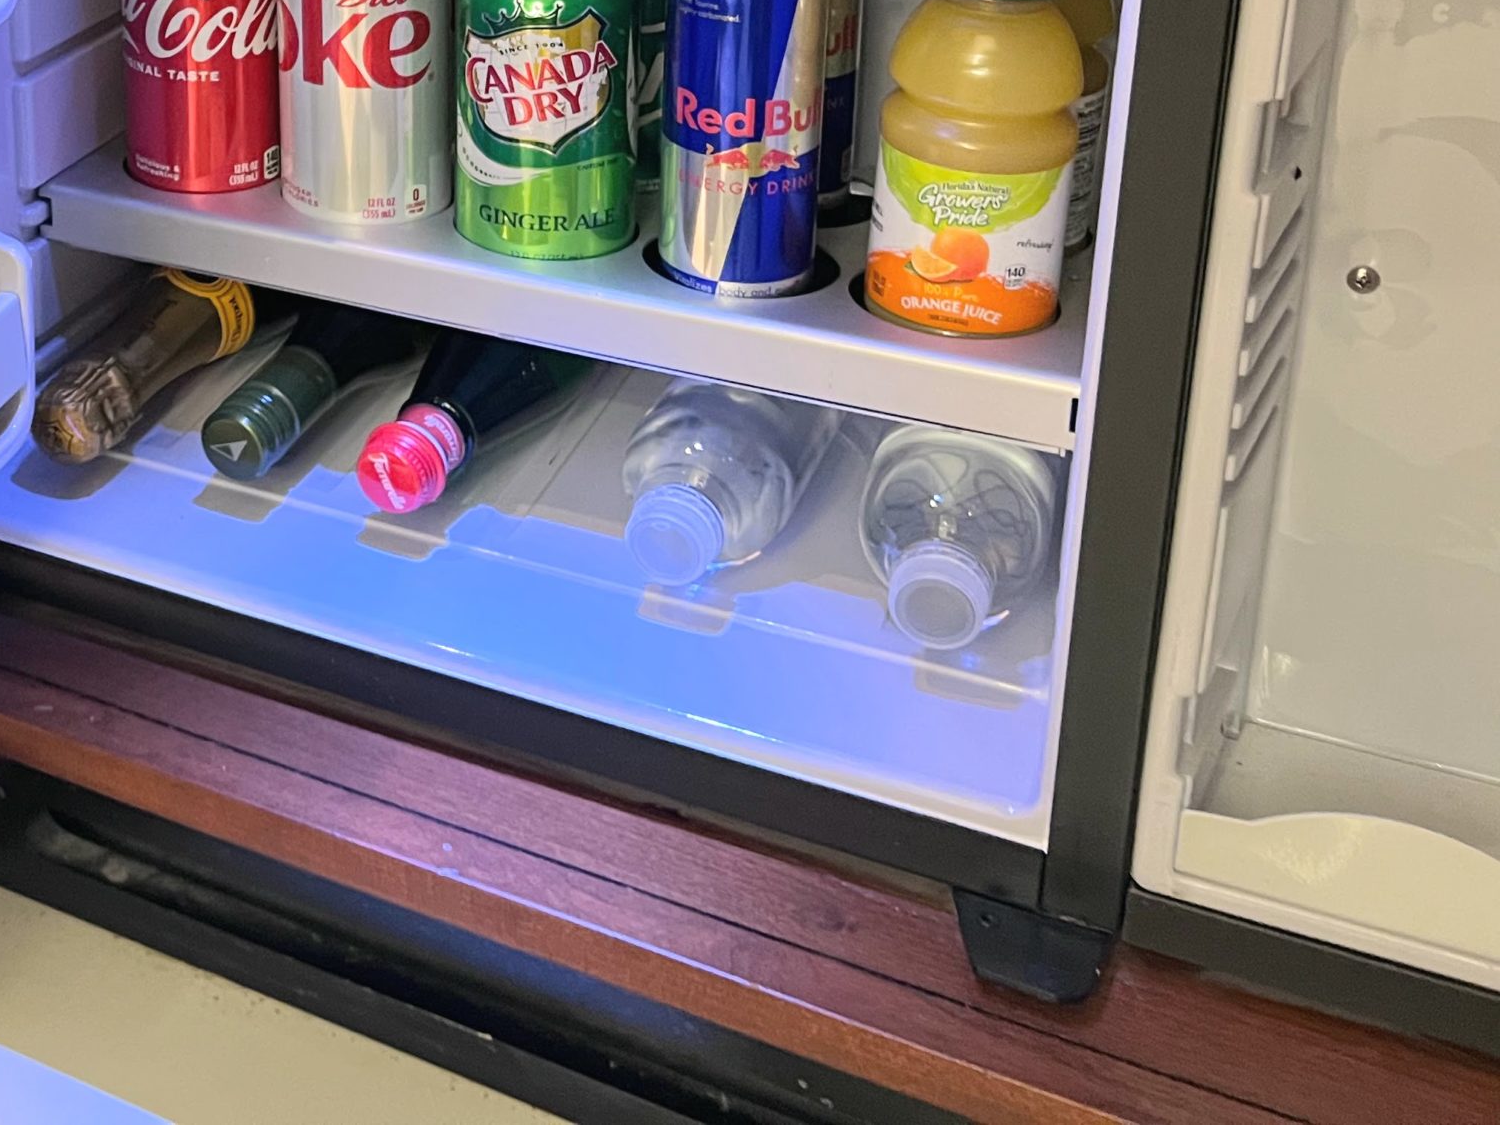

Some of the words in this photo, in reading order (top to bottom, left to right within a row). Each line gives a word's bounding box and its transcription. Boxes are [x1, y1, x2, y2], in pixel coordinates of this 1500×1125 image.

[499, 44, 529, 56] SINCE
[167, 69, 220, 82] TASTE
[466, 40, 618, 104] CANADA
[502, 81, 584, 127] DRY
[676, 86, 756, 138] Red
[412, 188, 420, 201] 0
[679, 168, 758, 195] ENERGY
[766, 174, 815, 196] DRINK
[367, 198, 376, 208] 12
[376, 198, 385, 208] FL
[386, 197, 396, 207] OZ
[479, 204, 569, 232] GINGER
[574, 207, 615, 231] ALE
[931, 205, 989, 227] Pride
[1007, 266, 1026, 277] 140
[900, 296, 961, 314] ORANGE
[962, 304, 1003, 326] JUICE
